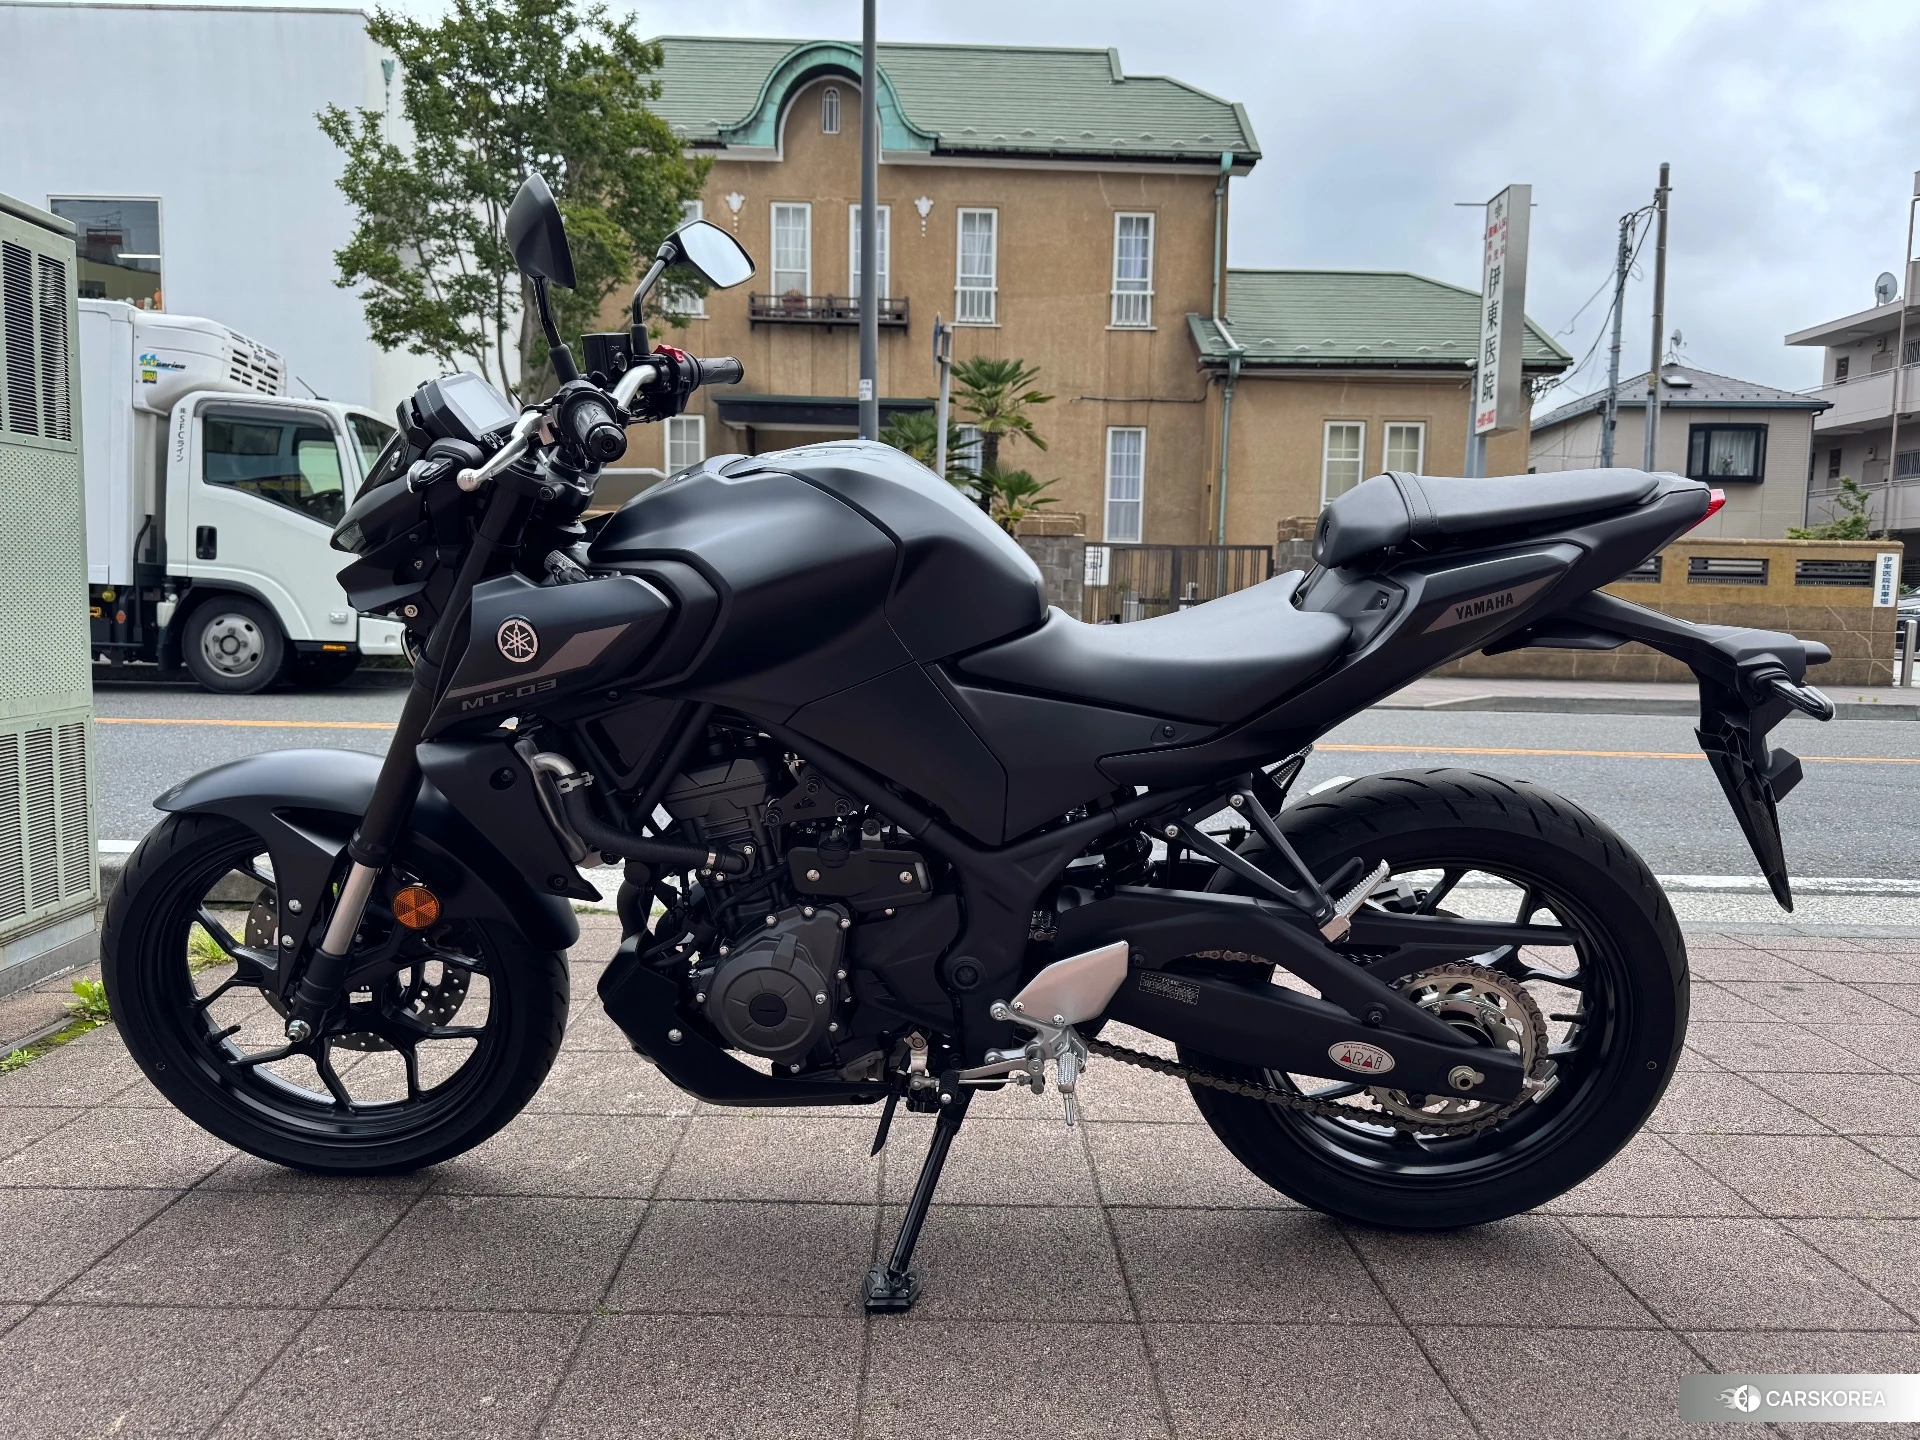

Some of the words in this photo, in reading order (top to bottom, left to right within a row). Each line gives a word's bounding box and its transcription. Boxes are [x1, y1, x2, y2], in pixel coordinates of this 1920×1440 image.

[1481, 264, 1501, 404] 伊東医院
[1880, 556, 1893, 605] 伊東医院駐車場
[1455, 592, 1514, 620] YAMAHA
[461, 678, 557, 711] MT-03
